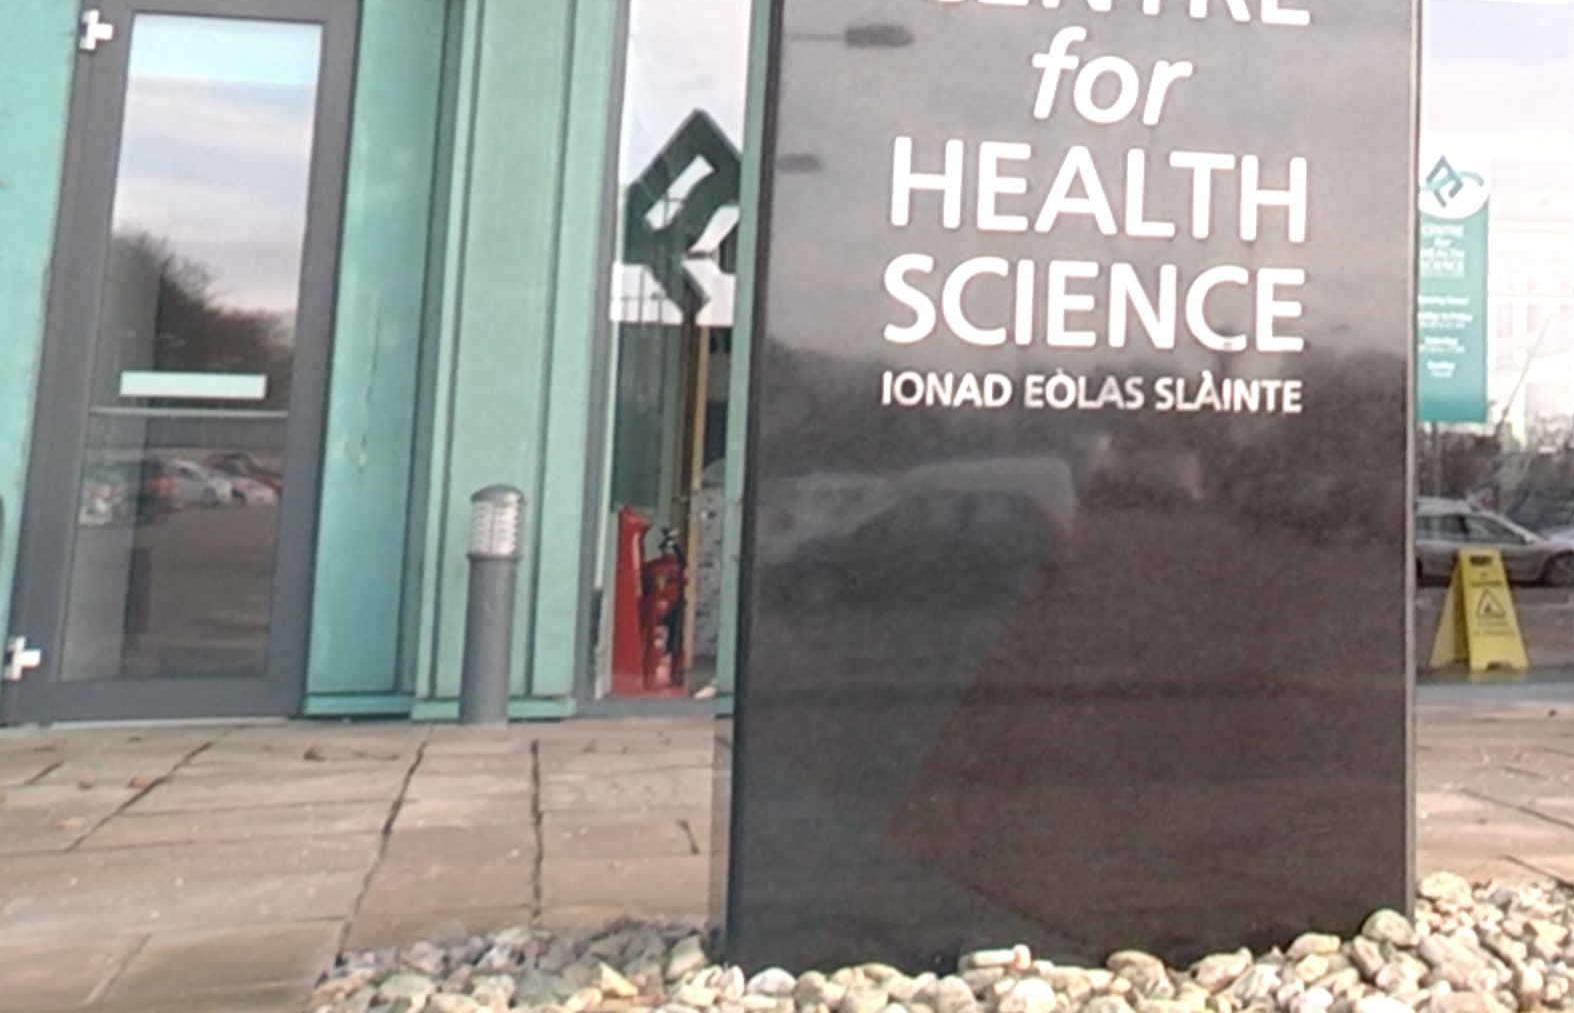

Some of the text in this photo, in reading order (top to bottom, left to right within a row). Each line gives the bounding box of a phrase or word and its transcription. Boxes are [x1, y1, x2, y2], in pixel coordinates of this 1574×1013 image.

[1031, 26, 1194, 125] for
[891, 135, 1308, 243] HEALTH
[883, 253, 1305, 353] SCIENCE
[882, 367, 1303, 413] IONAD EÒLAS SLÀINTE
